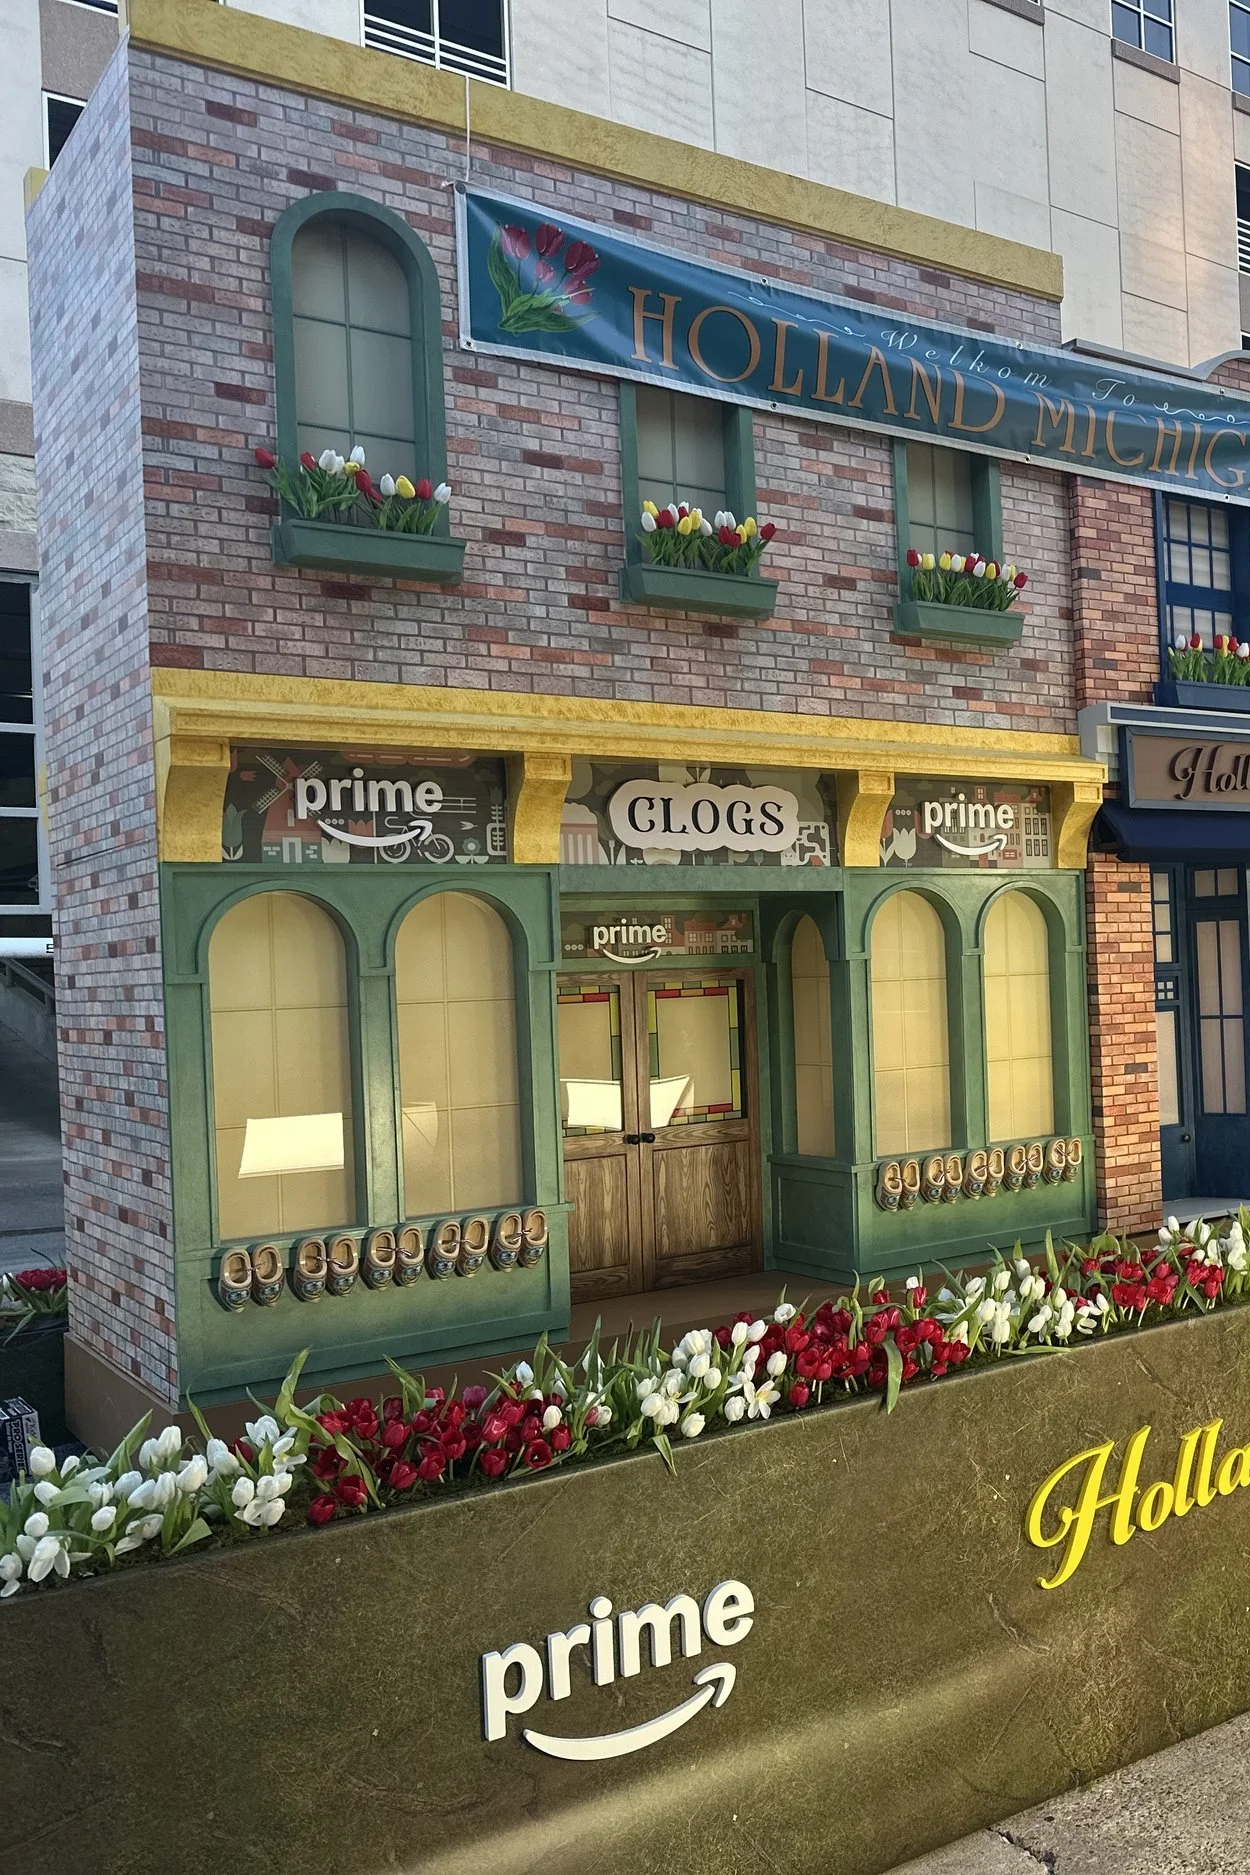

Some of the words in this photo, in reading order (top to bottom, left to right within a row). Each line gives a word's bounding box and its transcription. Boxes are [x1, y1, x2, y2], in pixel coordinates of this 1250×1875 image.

[627, 286, 1005, 433] HOLLAND
[880, 327, 1053, 388] Welkom
[1092, 377, 1137, 408] To
[295, 767, 444, 820] prime
[627, 795, 785, 836] CLOGS
[924, 793, 1014, 833] prime
[593, 918, 667, 951] prime
[12, 1419, 22, 1441] PRO
[482, 1579, 755, 1742] prime
